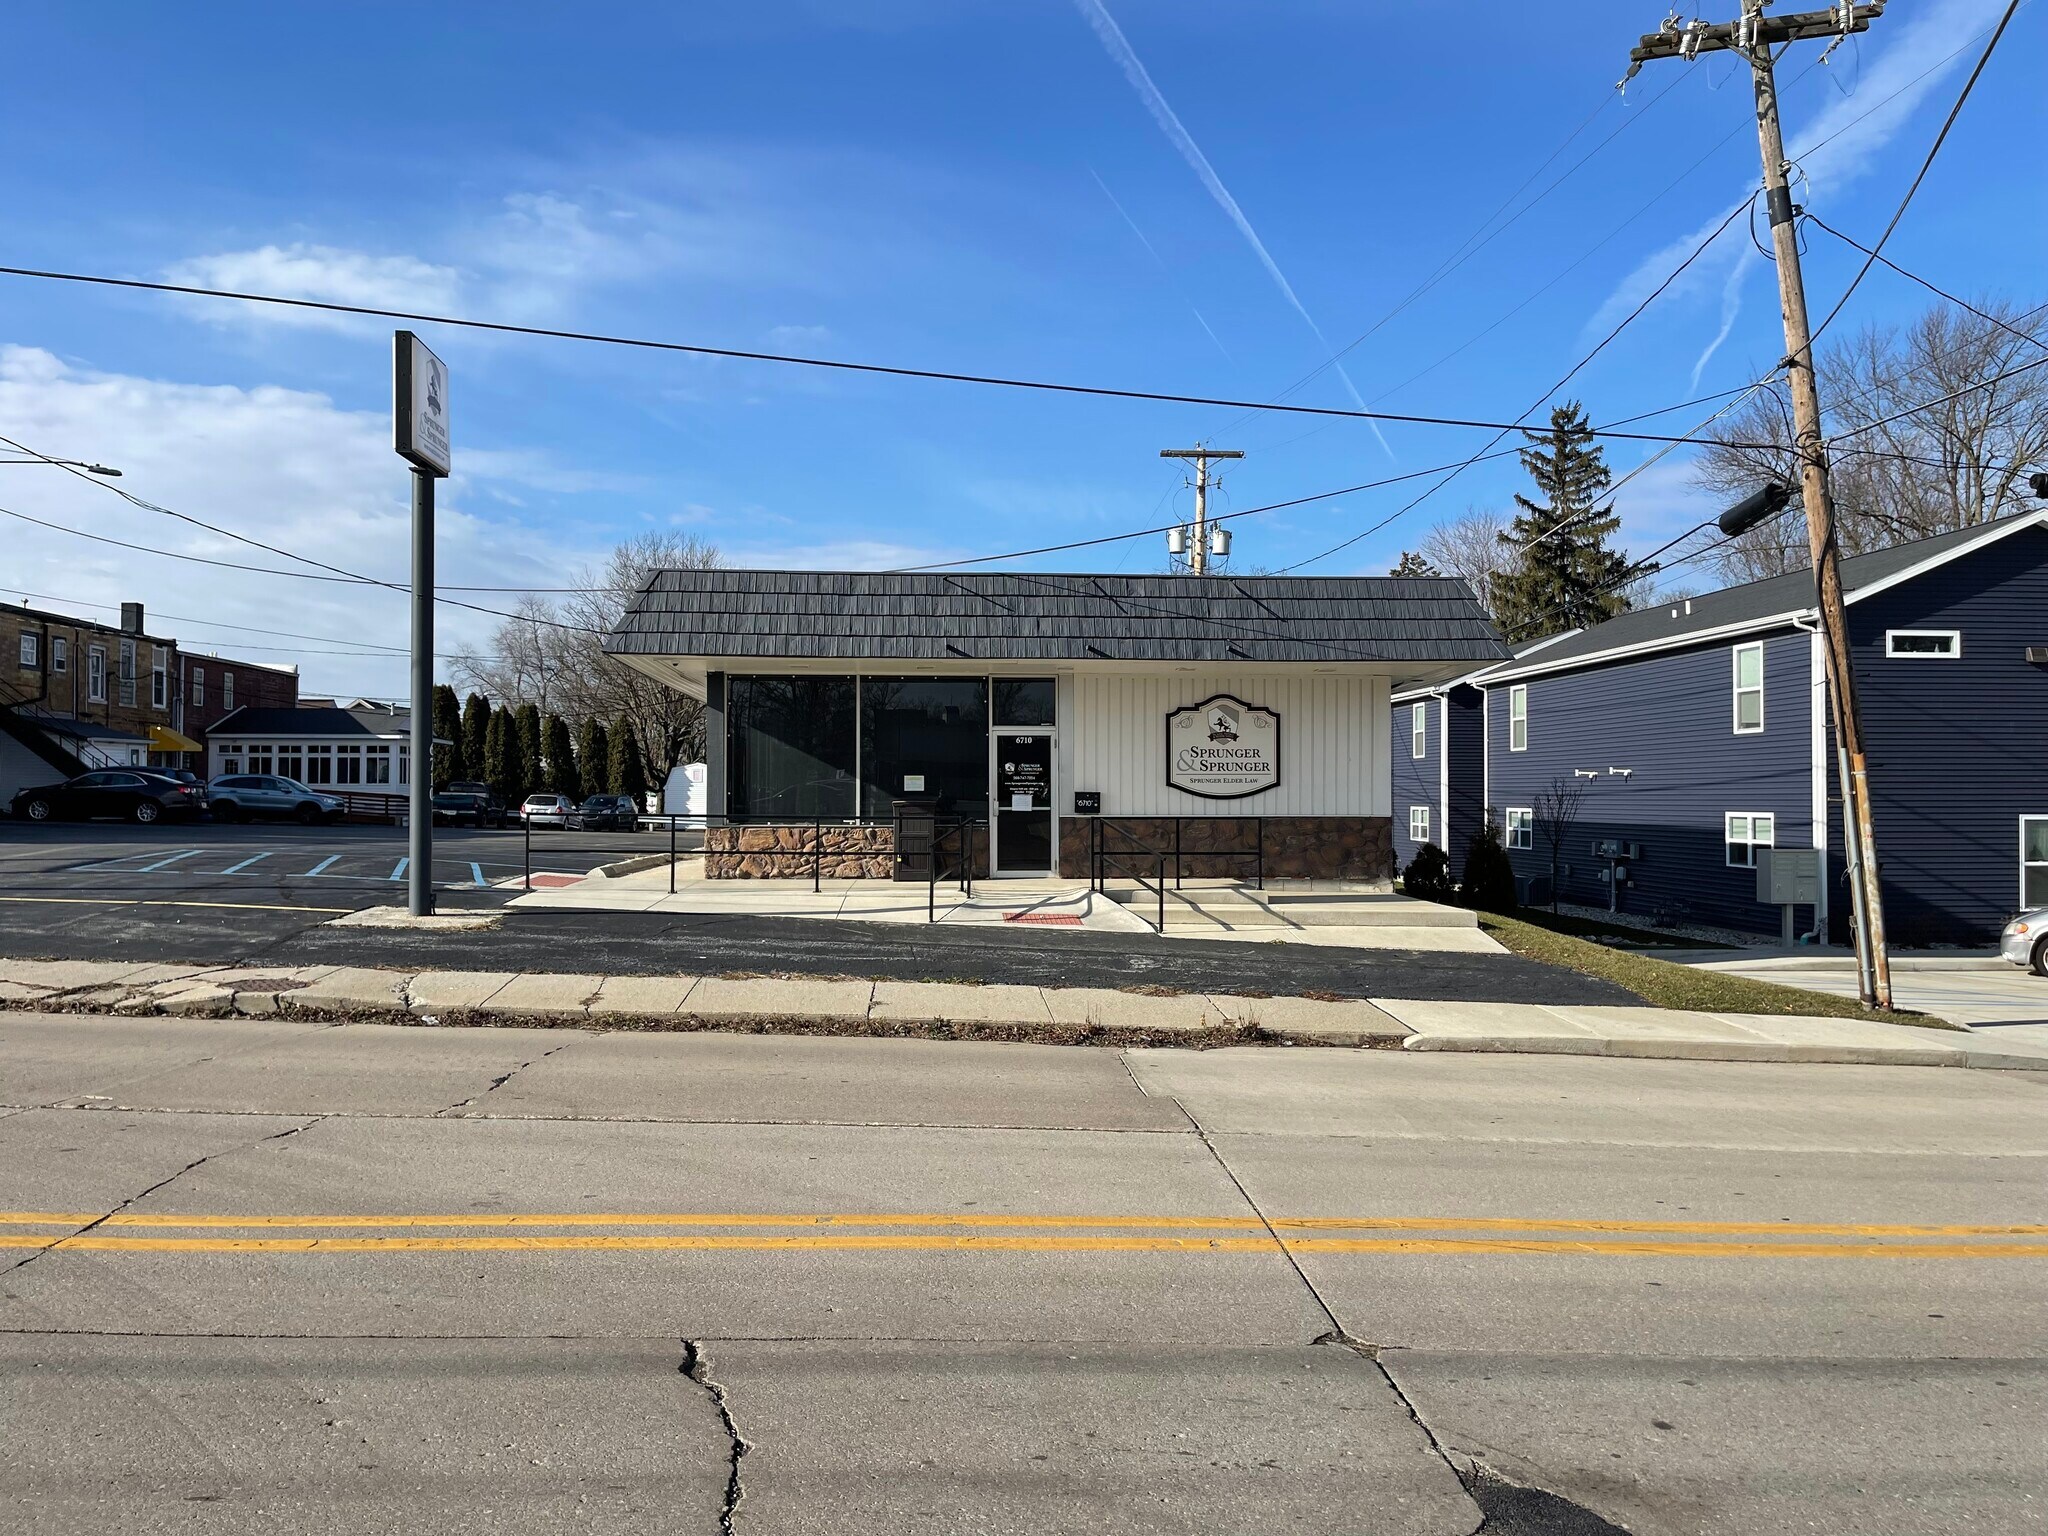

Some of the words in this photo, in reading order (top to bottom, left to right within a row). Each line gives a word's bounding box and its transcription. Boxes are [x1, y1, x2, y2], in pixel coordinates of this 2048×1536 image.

[1176, 749, 1199, 772] &
[1199, 759, 1271, 772] SPRUNGER
[1190, 745, 1261, 758] SPRUNGER
